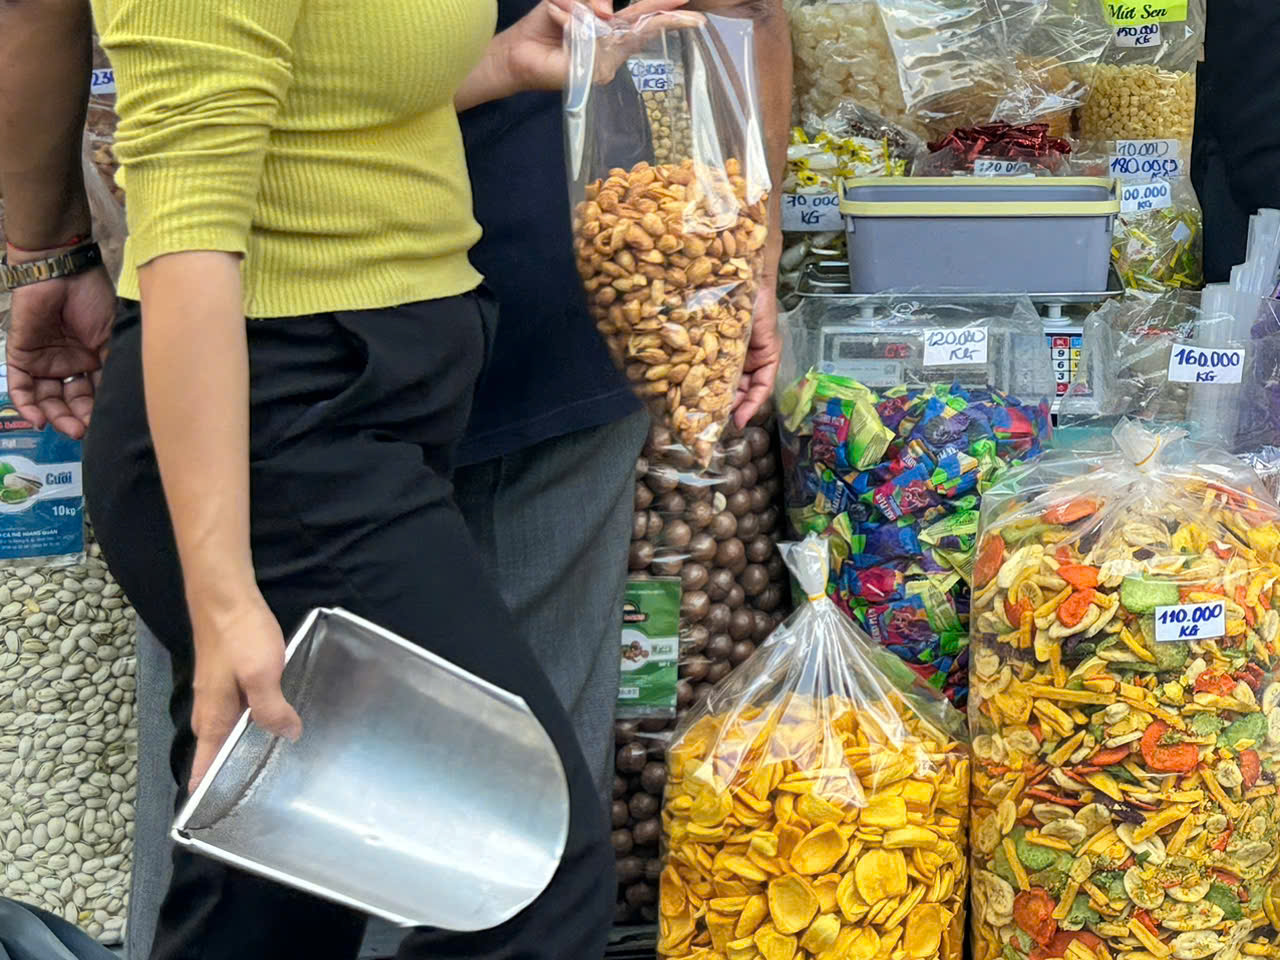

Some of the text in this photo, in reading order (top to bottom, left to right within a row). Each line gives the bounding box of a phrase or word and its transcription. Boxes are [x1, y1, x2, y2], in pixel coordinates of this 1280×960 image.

[1140, 4, 1168, 19] Sen
[801, 210, 826, 226] KG
[1174, 348, 1241, 369] 160.000
[1195, 370, 1218, 383] KG
[52, 505, 76, 517] 10kg
[1158, 604, 1223, 625] 110.000
[1178, 625, 1200, 638] KG
